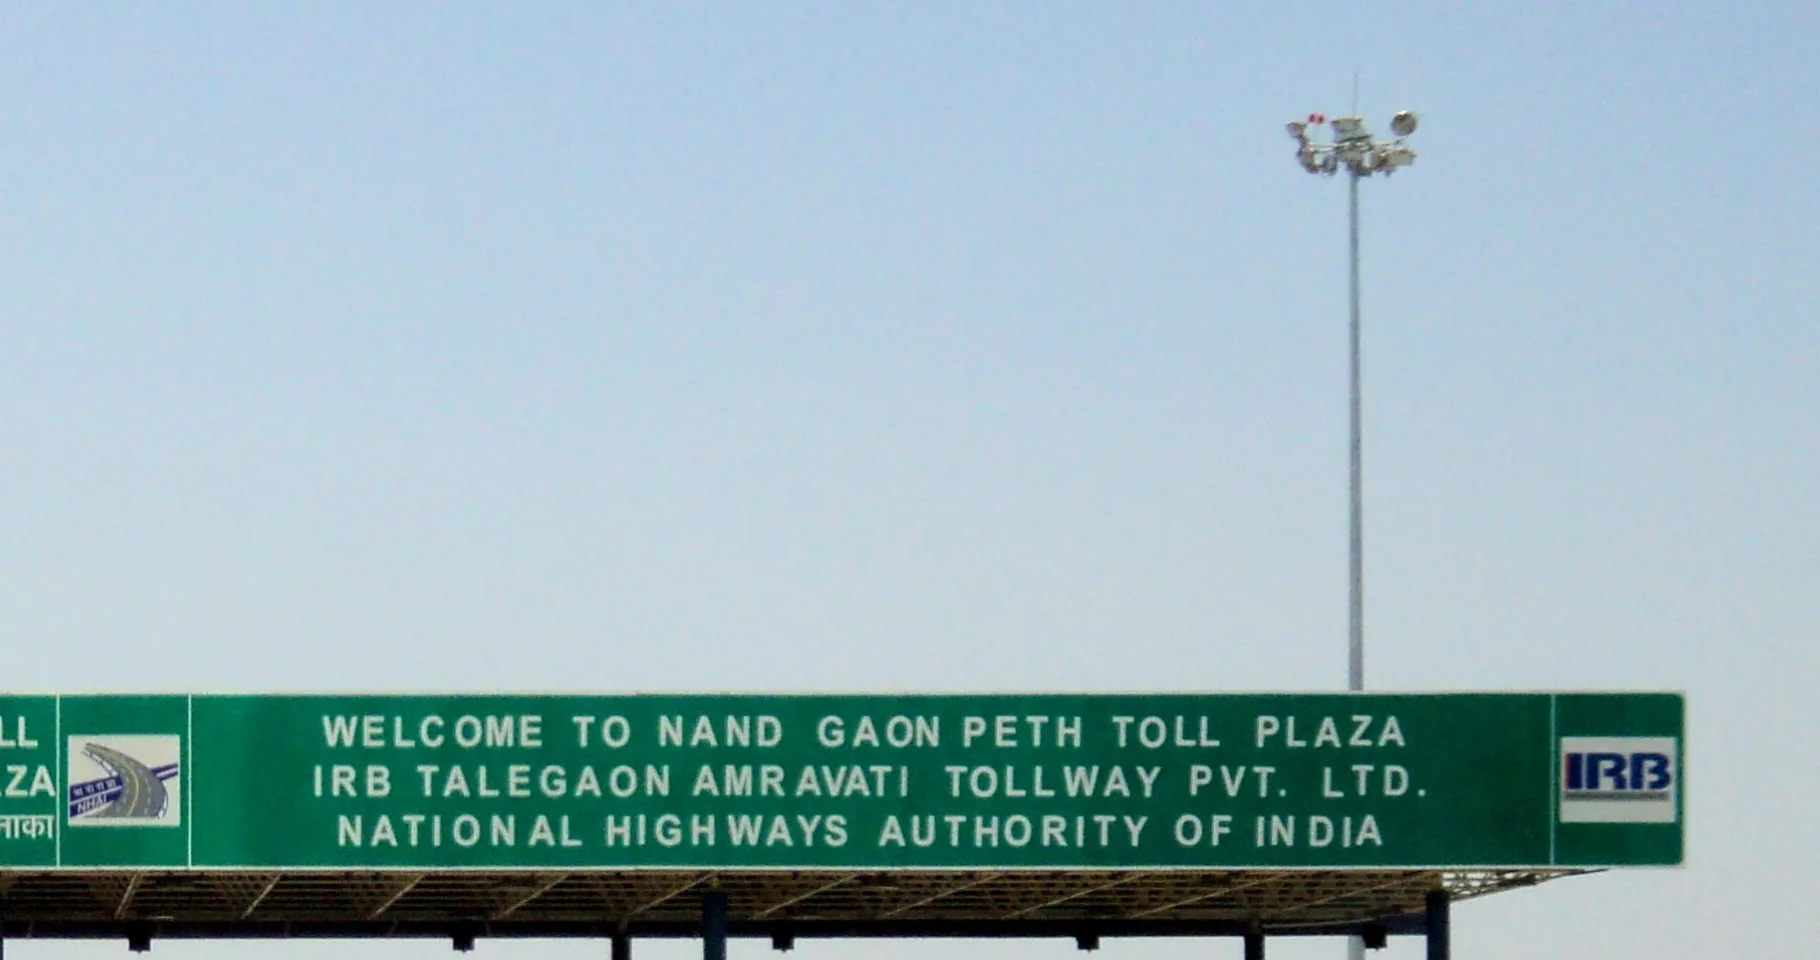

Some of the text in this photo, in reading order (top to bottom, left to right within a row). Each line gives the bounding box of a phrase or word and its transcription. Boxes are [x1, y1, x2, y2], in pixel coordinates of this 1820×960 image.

[322, 715, 1405, 749] WELCOME TO NAND GAON PETH TOLL PLAZA
[314, 764, 1425, 798] IRB TALEGAON AMRAVATI TOLLWAY PVT. LTD.
[1564, 752, 1671, 790] IRB
[338, 814, 1382, 847] NATIONAL HIGHWAYS AUTHORITY OF INDIA
